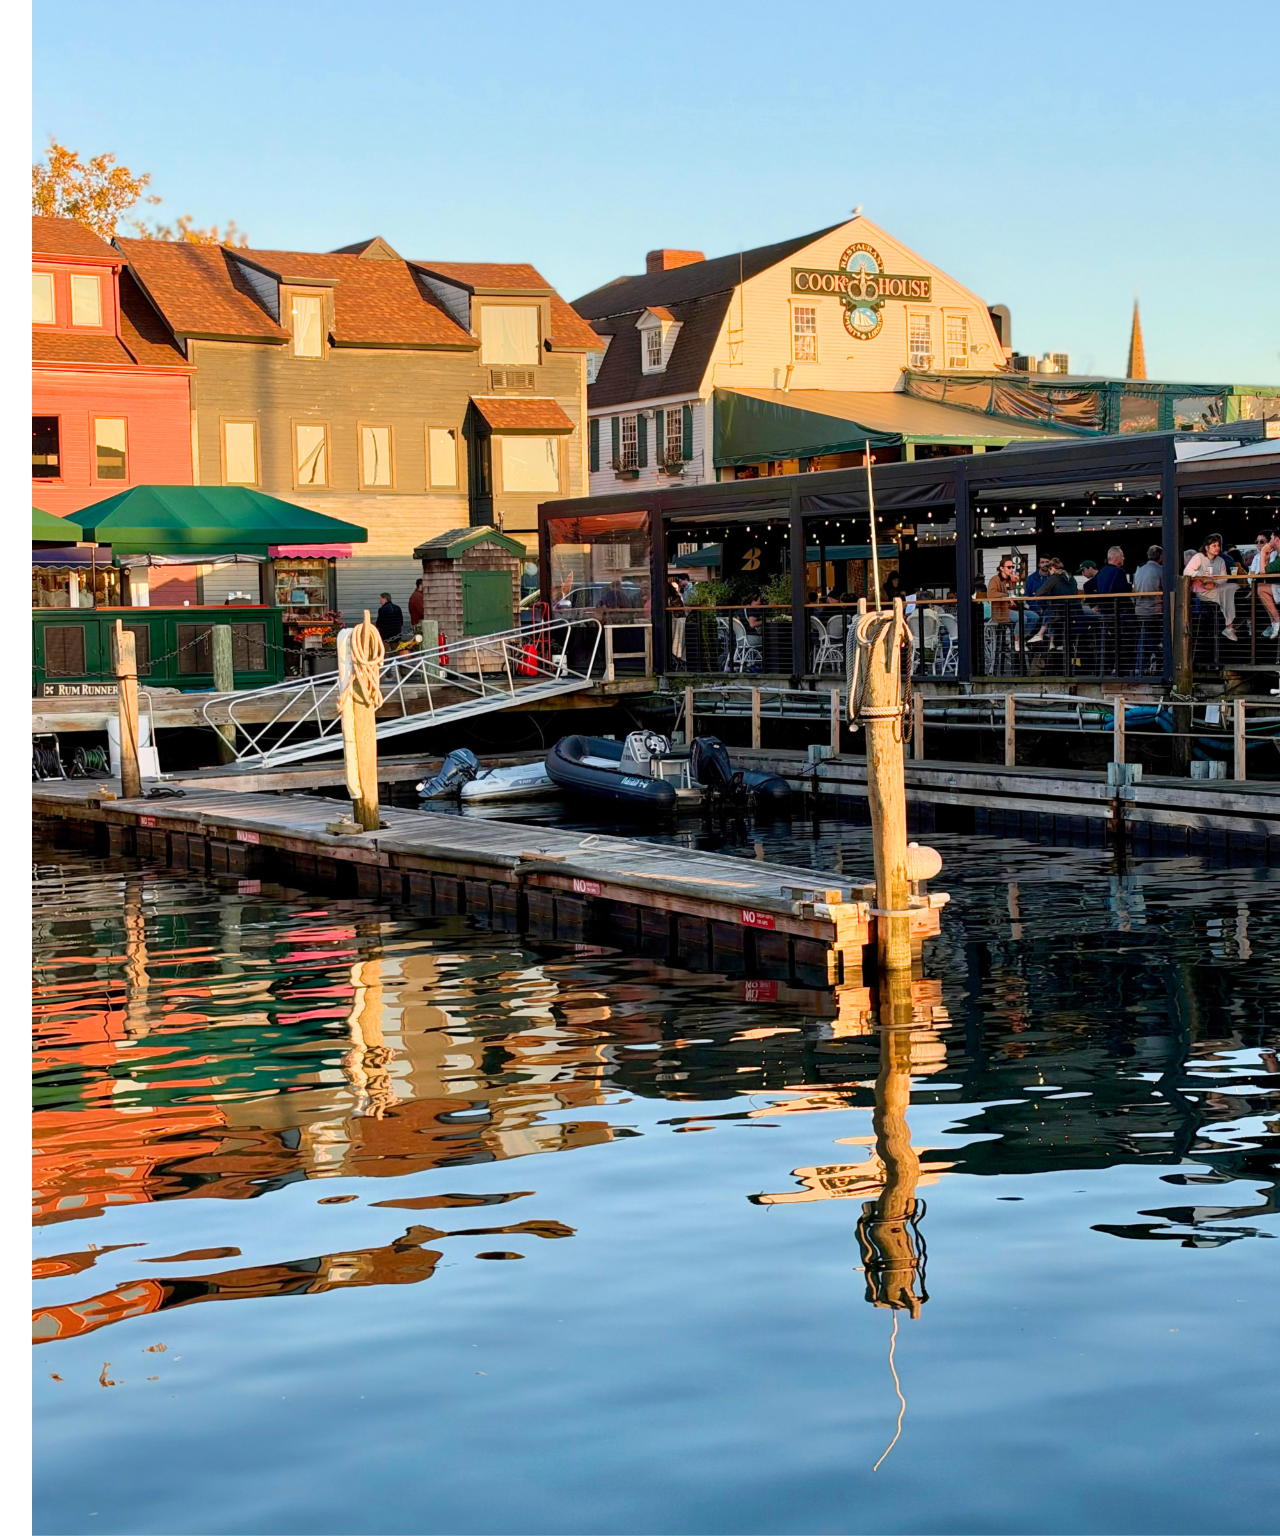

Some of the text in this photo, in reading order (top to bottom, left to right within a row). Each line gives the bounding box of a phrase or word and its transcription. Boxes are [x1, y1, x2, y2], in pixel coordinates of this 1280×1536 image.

[839, 243, 884, 271] RESTAURANT
[878, 278, 930, 298] HOUSE
[58, 684, 80, 695] RUM
[573, 878, 586, 892] NO
[742, 910, 756, 923] NO
